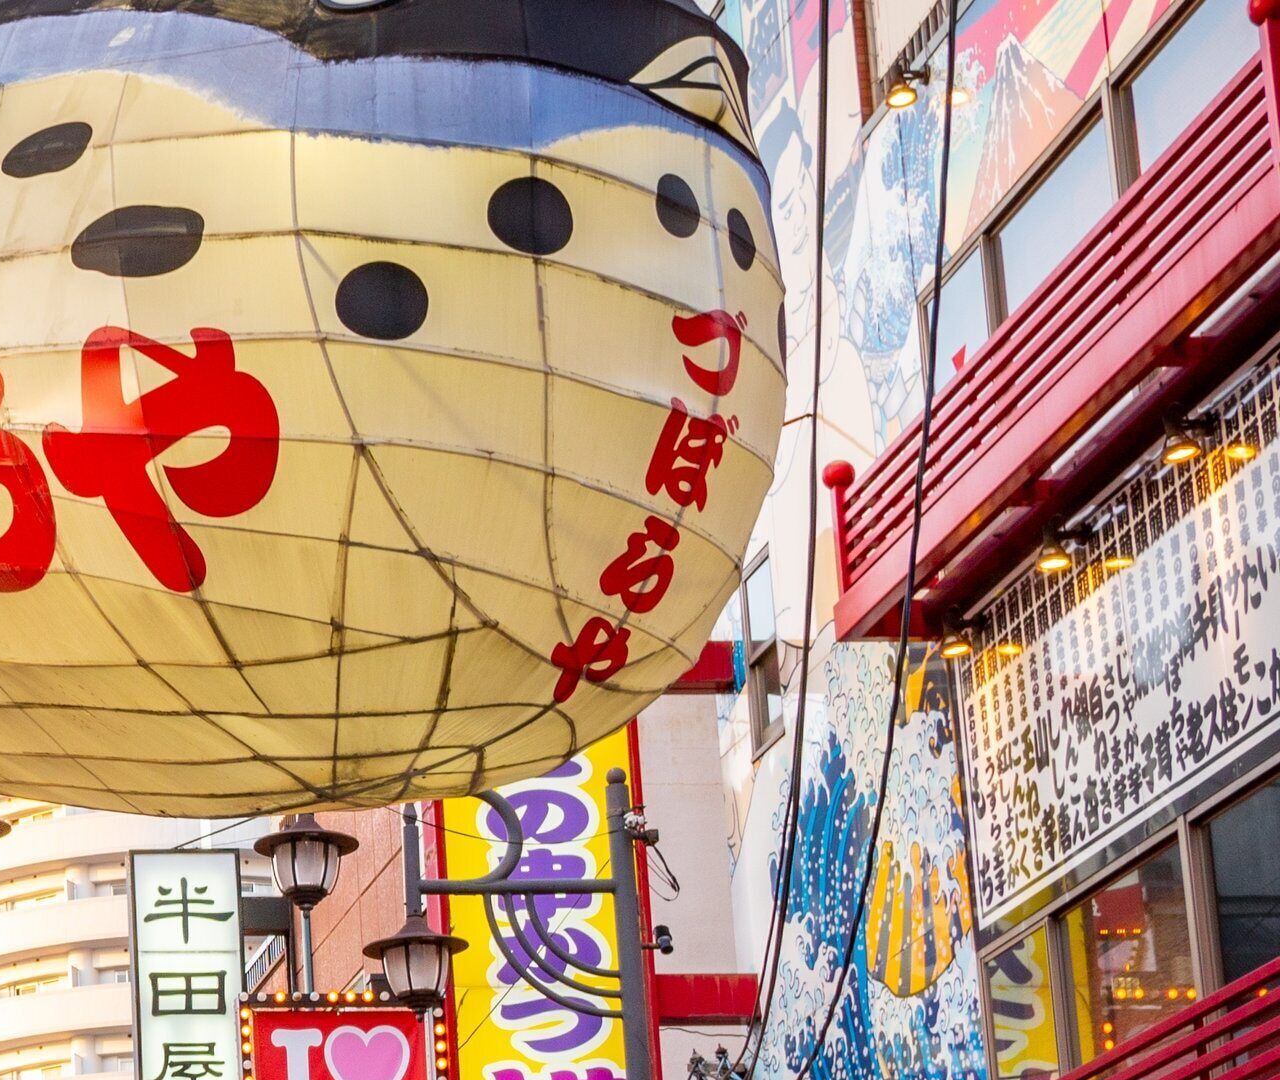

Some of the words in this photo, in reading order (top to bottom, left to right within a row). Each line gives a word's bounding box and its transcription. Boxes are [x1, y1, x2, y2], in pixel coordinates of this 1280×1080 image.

[551, 308, 749, 704] づぼらや
[486, 759, 604, 1052] の串かつ
